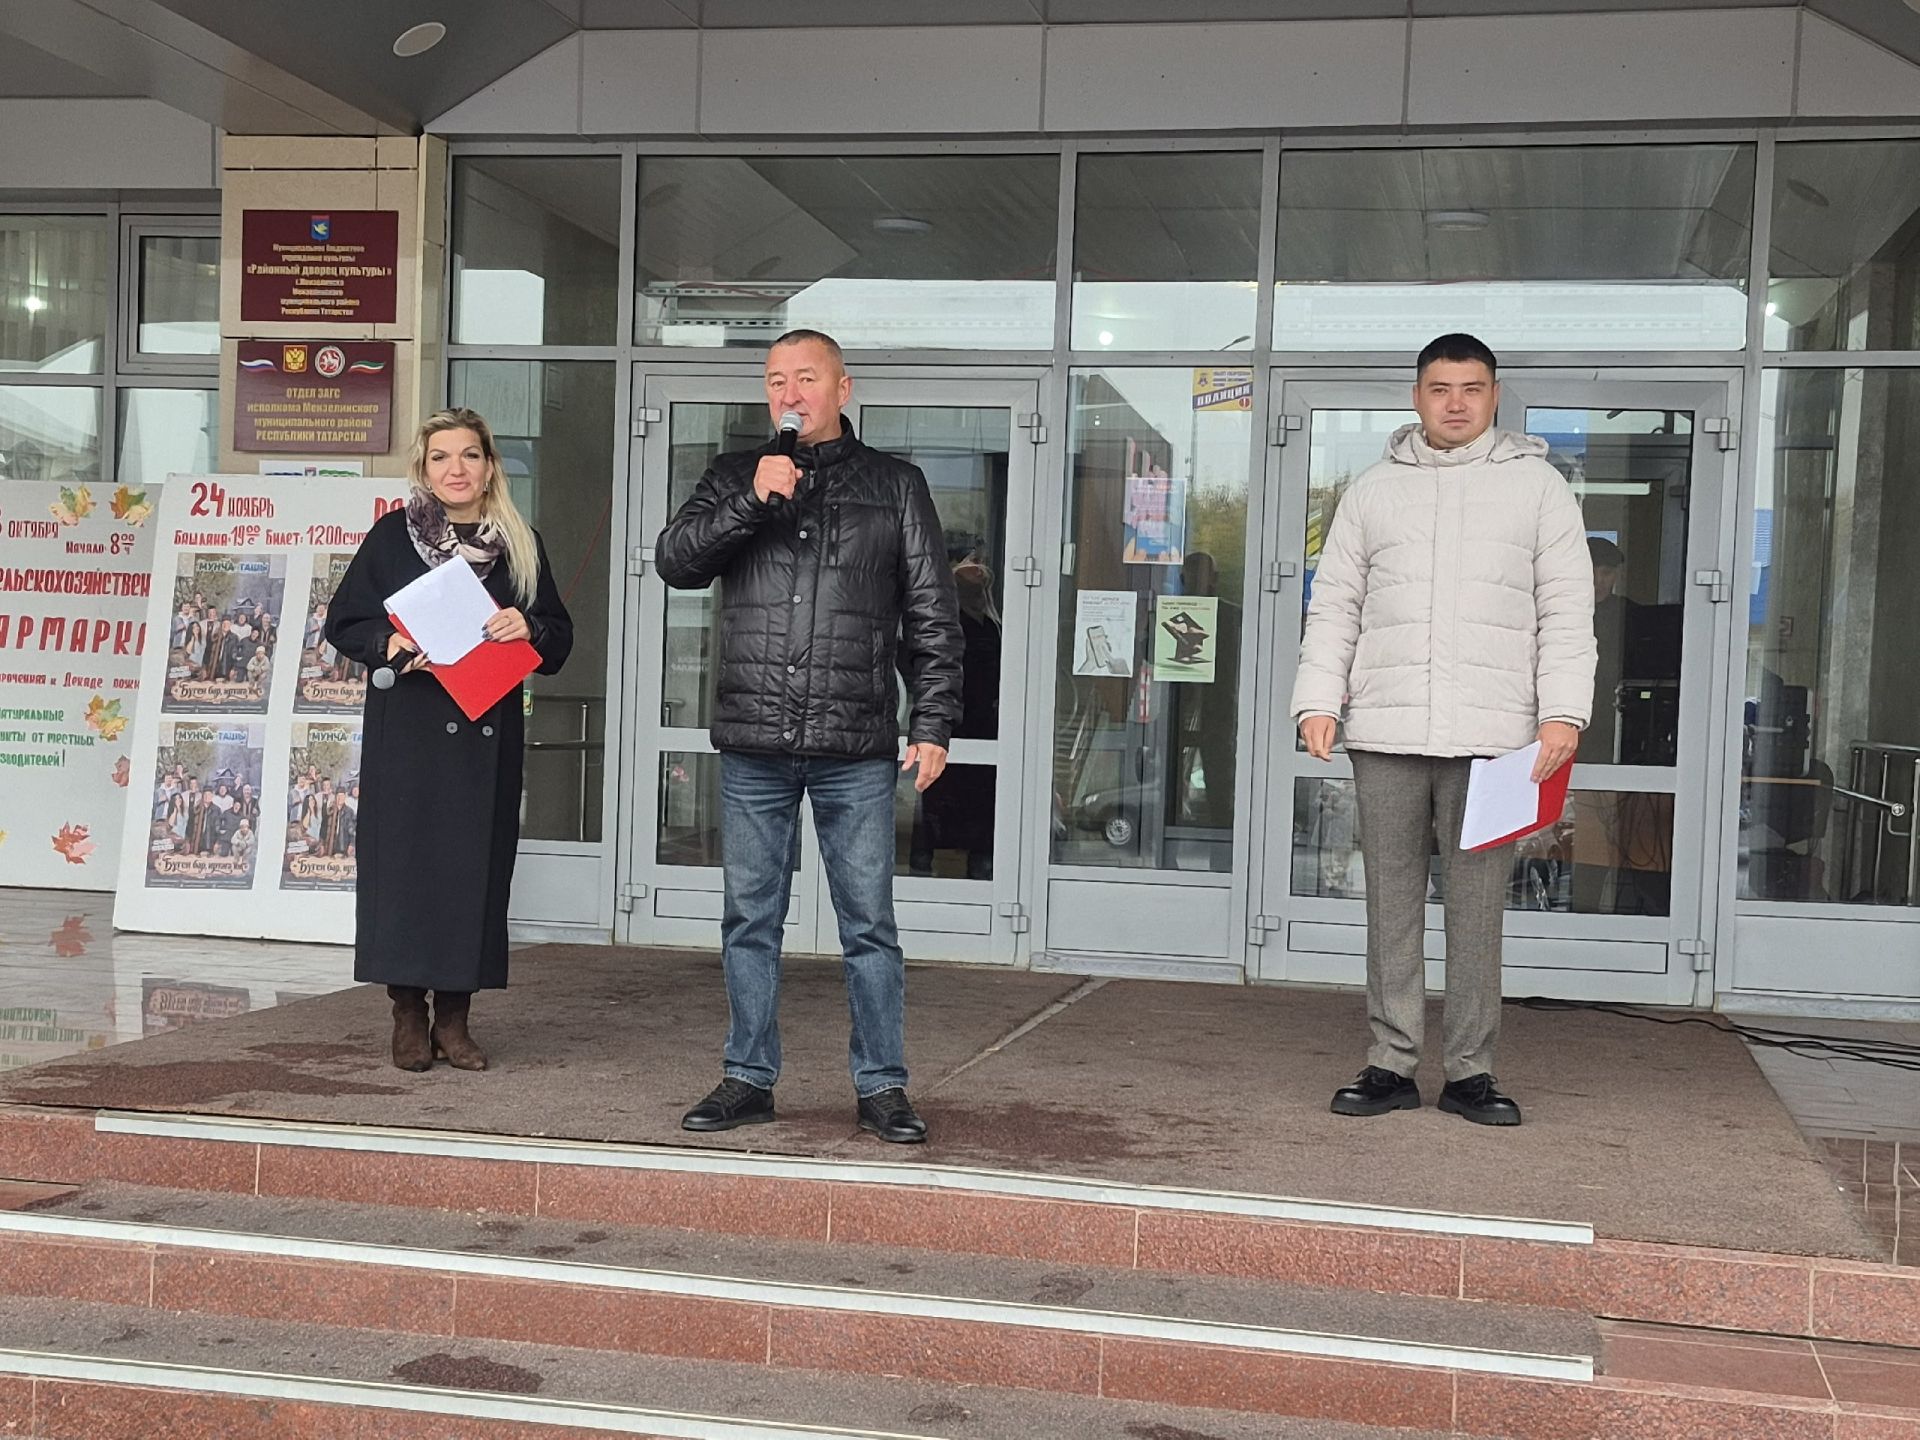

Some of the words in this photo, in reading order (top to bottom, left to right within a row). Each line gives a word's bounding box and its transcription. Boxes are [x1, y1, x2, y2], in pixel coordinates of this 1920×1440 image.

[302, 266, 337, 277] дворец
[286, 388, 316, 399] ОТДЕЛ
[318, 388, 341, 398] ЗАГС
[302, 402, 379, 414] Мензелинского
[254, 418, 336, 428] муниципального
[337, 416, 373, 428] района
[256, 430, 315, 442] РЕСПУБЛИКИ
[316, 431, 367, 442] ТАТАРСТАН
[190, 482, 225, 517] 24
[228, 497, 274, 518] НОЯБРЬ
[8, 520, 59, 539] ОКТЯБРЯ
[199, 561, 235, 572] МУНЧА
[0, 708, 64, 722] атуральные
[178, 729, 214, 742] МУНЧА
[311, 730, 348, 743] МУНЧА
